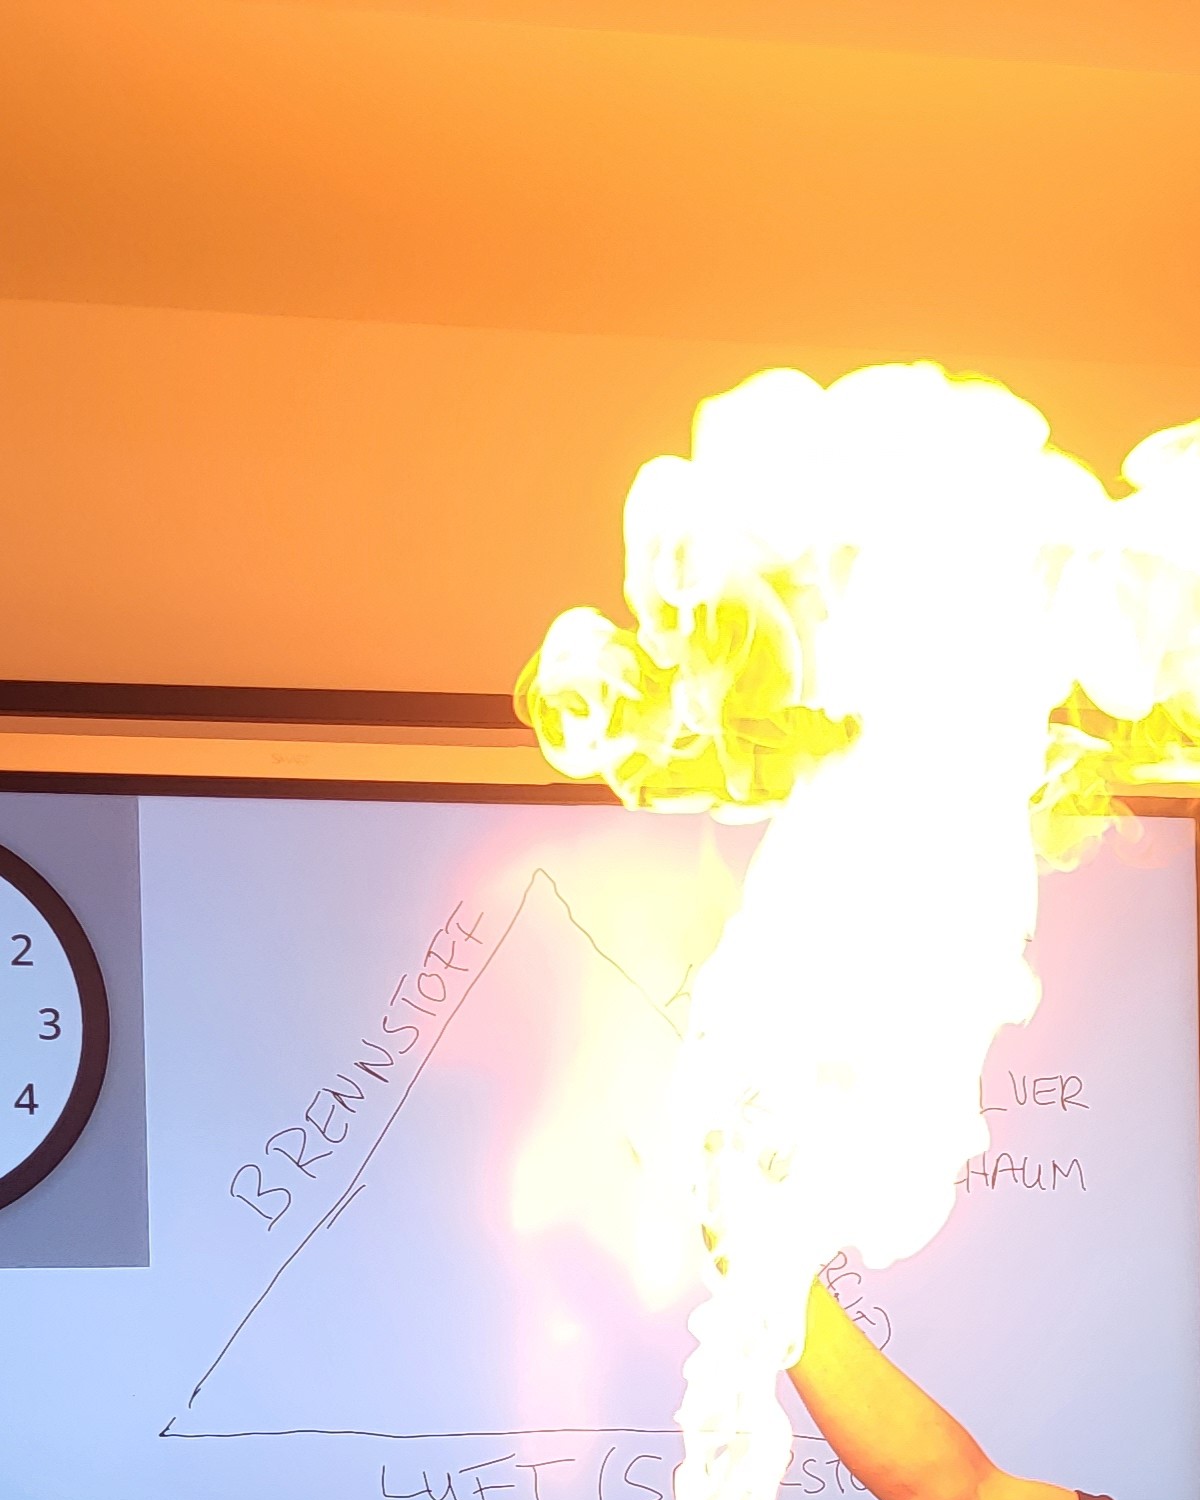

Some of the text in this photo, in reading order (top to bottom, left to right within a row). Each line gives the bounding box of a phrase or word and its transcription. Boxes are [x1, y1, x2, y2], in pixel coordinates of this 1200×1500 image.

[11, 934, 34, 966] 2
[38, 1007, 62, 1041] 3
[230, 900, 484, 1232] BRENNSTOFF
[14, 1083, 39, 1115] 4
[979, 1070, 1090, 1114] LVER
[953, 1151, 1087, 1193] HAUM
